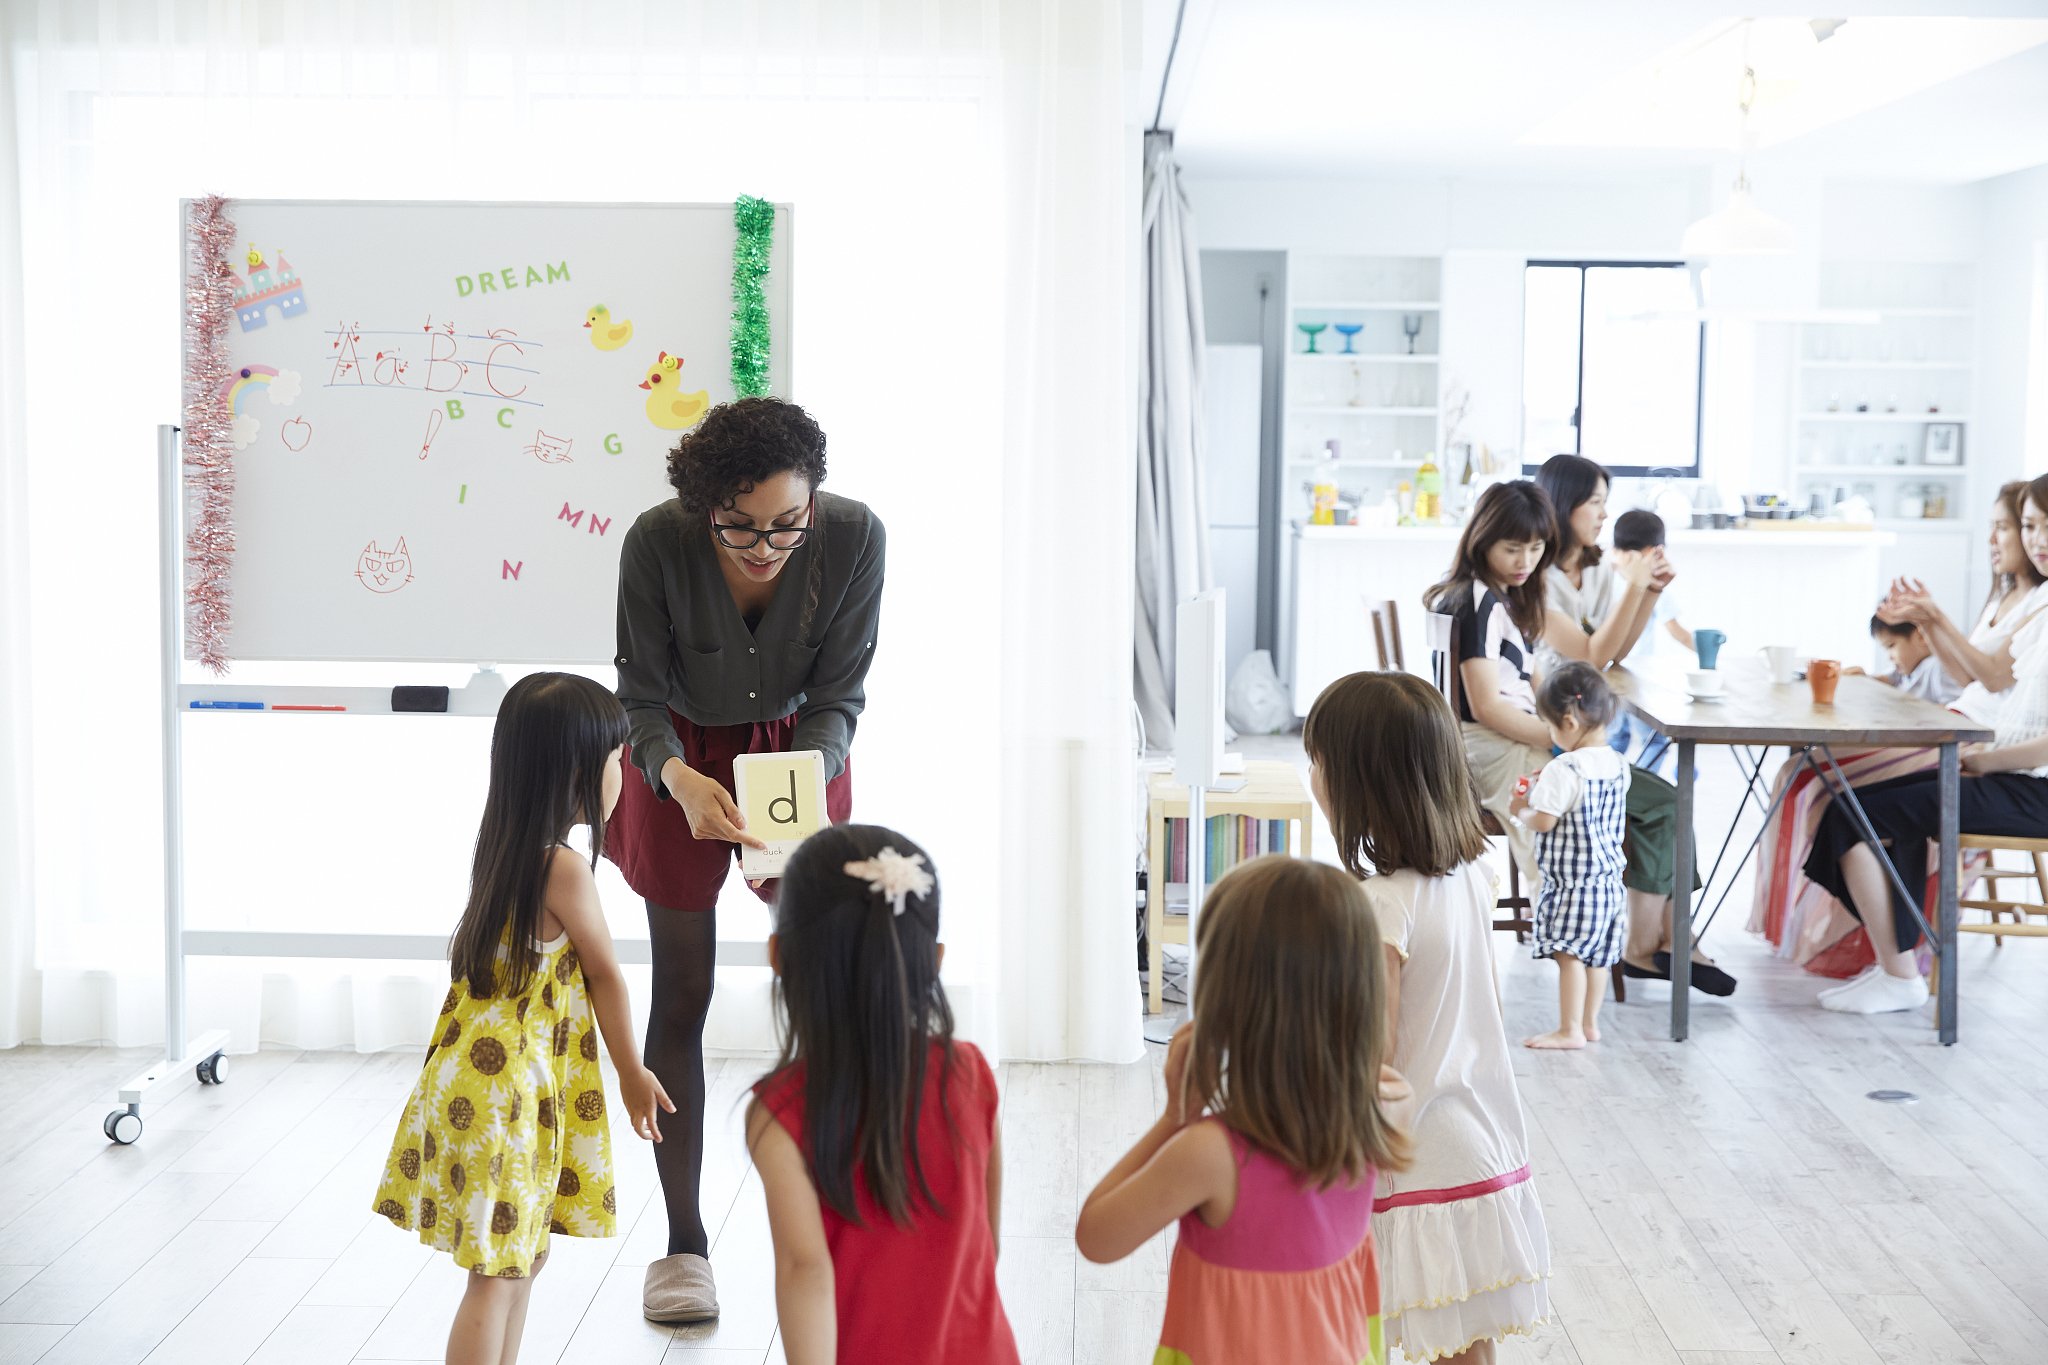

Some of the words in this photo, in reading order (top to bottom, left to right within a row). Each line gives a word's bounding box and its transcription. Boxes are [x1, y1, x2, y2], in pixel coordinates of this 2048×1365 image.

[455, 261, 570, 297] DREAM
[603, 433, 623, 455] G
[502, 559, 523, 581] N
[768, 769, 798, 824] d
[763, 846, 783, 856] duck
